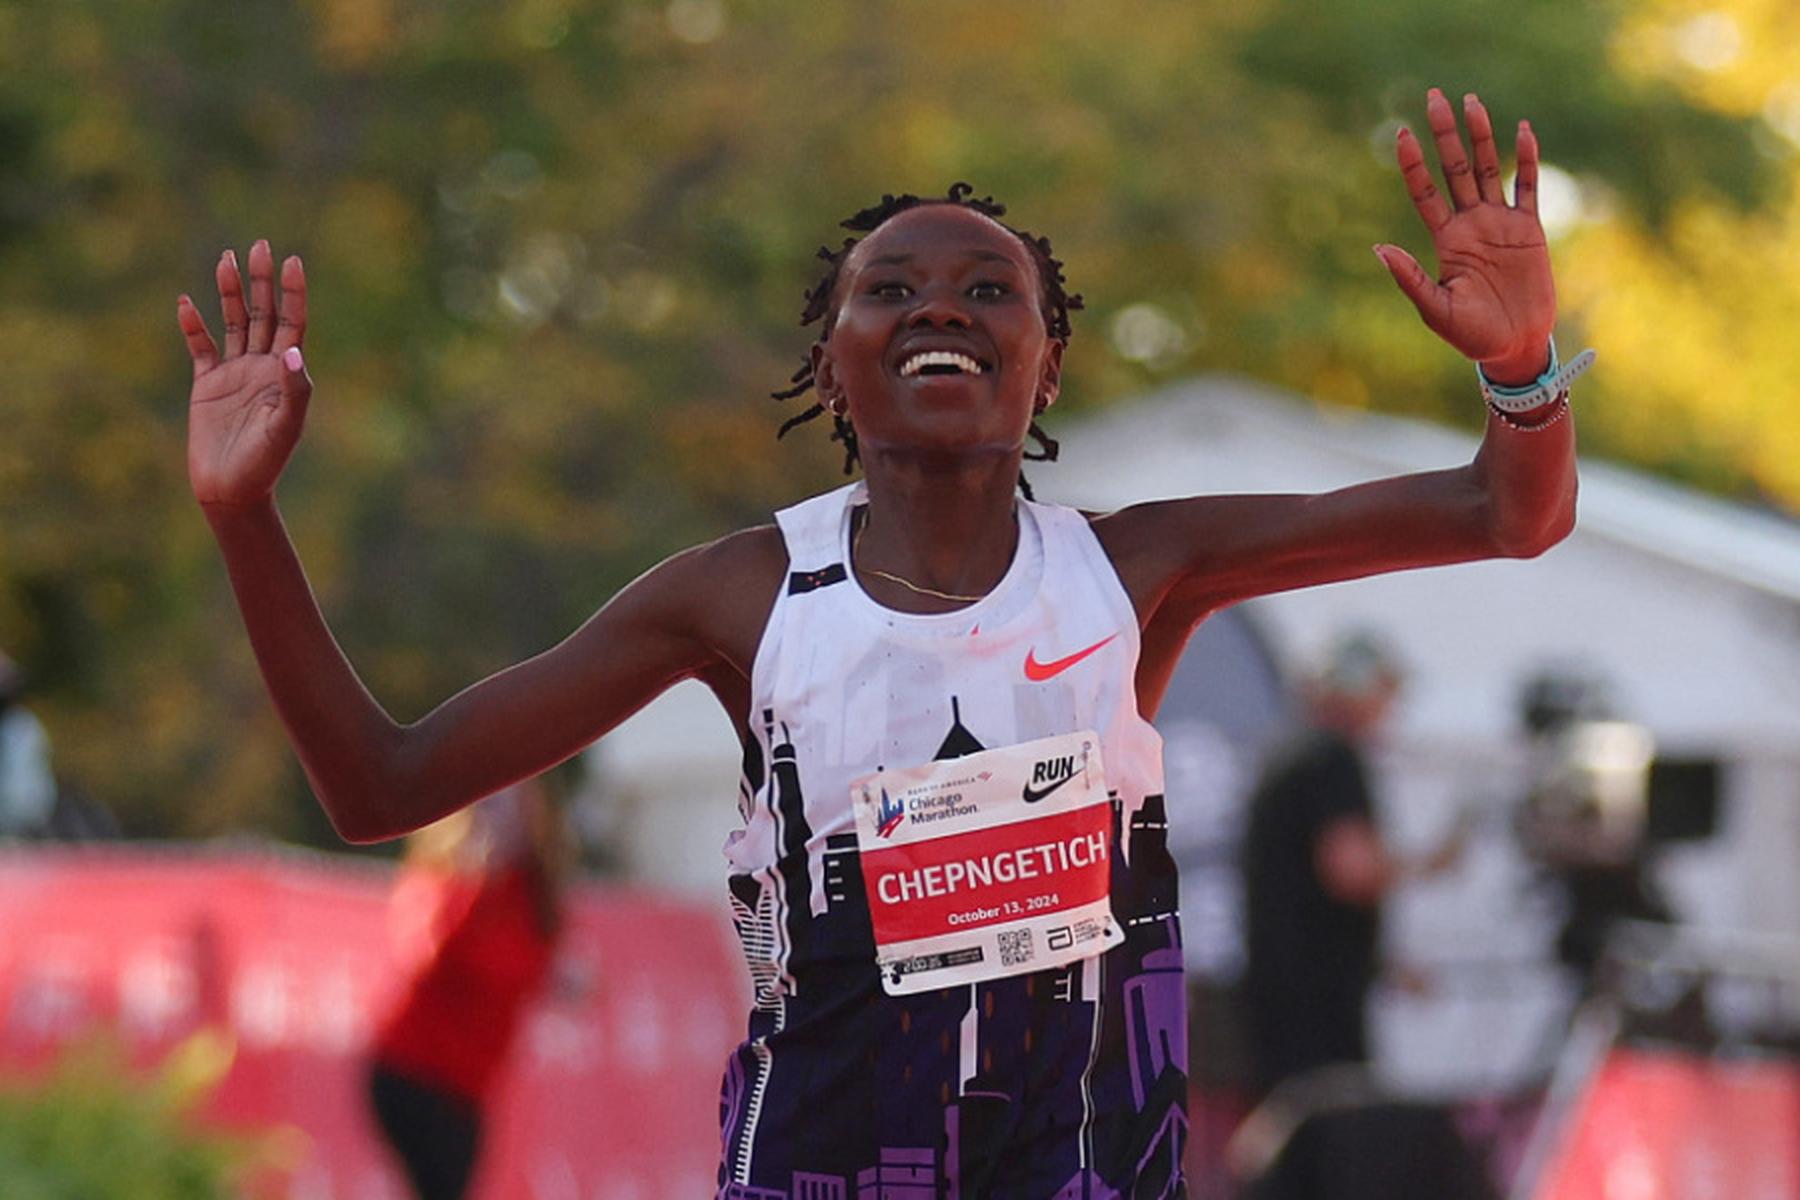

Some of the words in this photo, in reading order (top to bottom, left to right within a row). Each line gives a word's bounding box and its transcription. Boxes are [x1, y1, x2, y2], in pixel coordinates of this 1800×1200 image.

[1033, 755, 1074, 784] RUN
[909, 792, 963, 811] Chicago
[910, 803, 978, 825] Marathon
[877, 831, 1107, 904] CHEPNGETICH
[947, 907, 1001, 925] October
[1003, 900, 1025, 915] 13,
[1026, 893, 1060, 911] 2024
